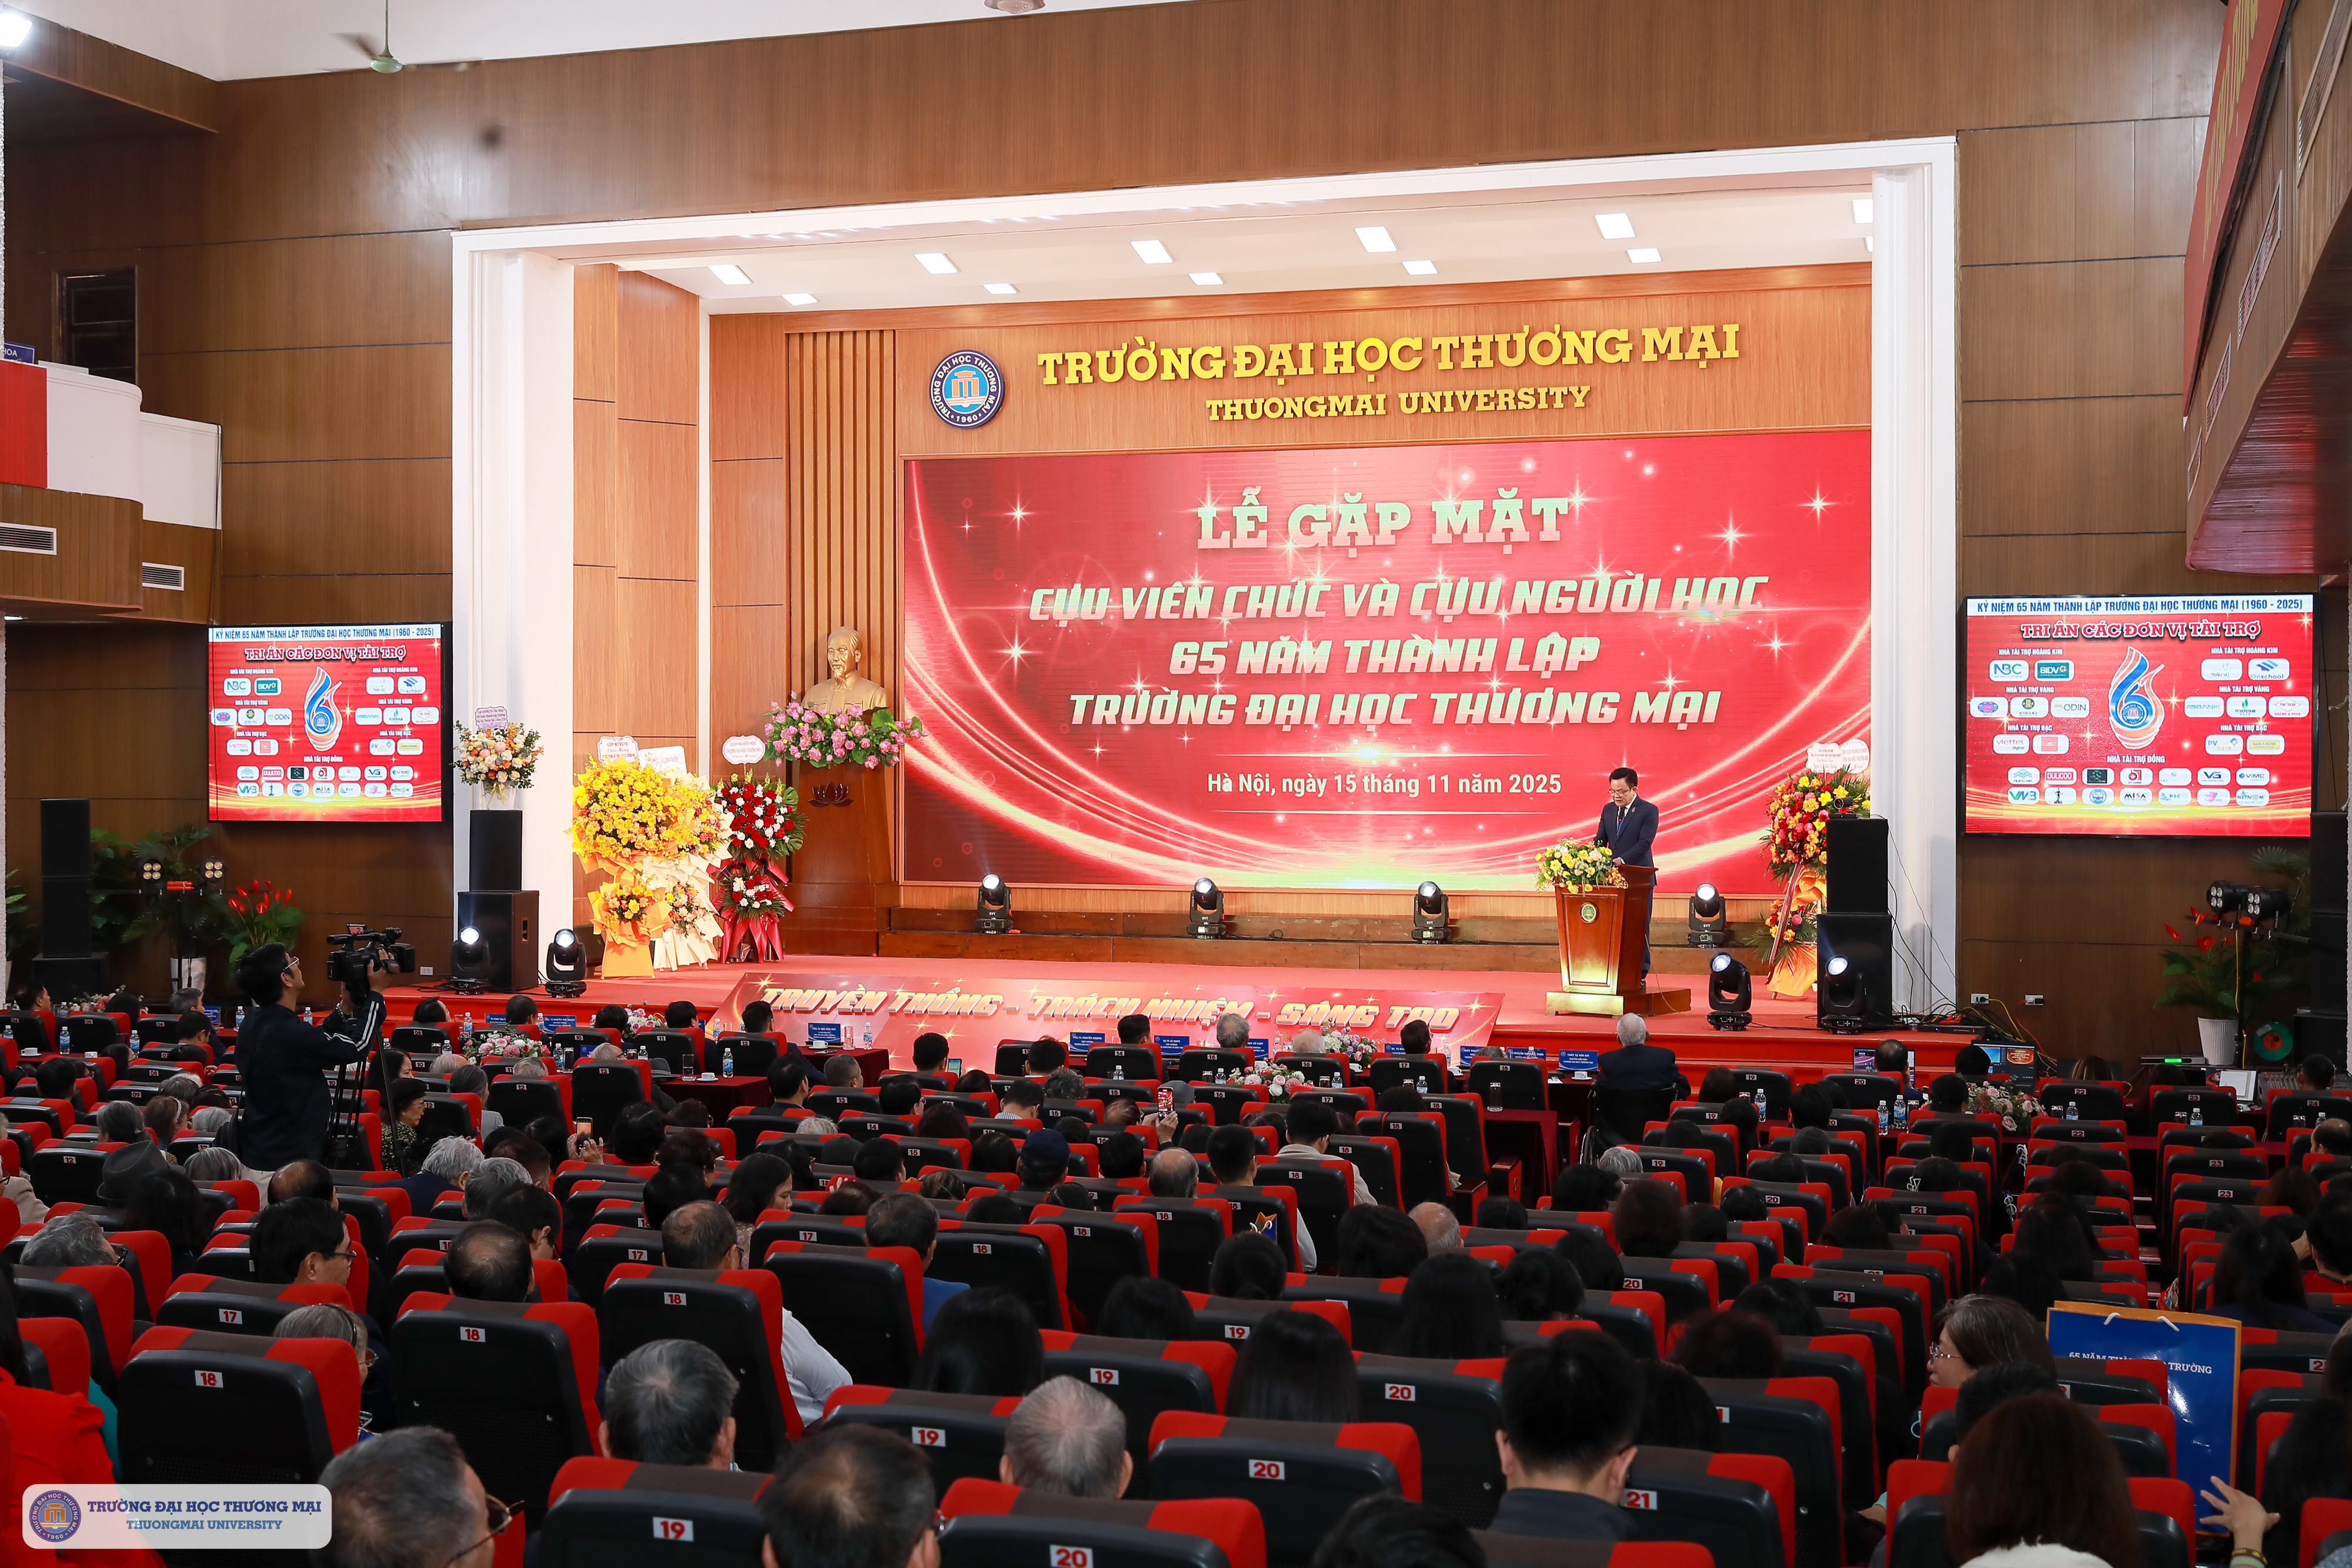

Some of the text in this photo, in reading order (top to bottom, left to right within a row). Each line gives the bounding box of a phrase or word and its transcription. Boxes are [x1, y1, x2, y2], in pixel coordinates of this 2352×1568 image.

[1038, 324, 1739, 385] TRƯỜNG ĐẠI HỌC THƯƠNG MẠI
[933, 355, 997, 418] TRƯỜNG ĐẠI HỌC THƯƠNG MẠI
[1206, 386, 1591, 421] THUONGMAI UNIVERSITY
[1197, 486, 1568, 558] LỄ GẶP MẶT
[1029, 570, 1769, 627] CỰU VIÊN CHỨC VÀ CỰU NGƯỜI HỌC
[1977, 600, 1988, 612] KỶ
[1992, 601, 2014, 614] NIỆM
[2017, 602, 2027, 611] 65
[2030, 600, 2050, 612] NĂM
[2054, 600, 2083, 612] THÀNH
[2085, 601, 2102, 613] LẬP
[2104, 600, 2140, 611] TRƯỜNG
[2143, 600, 2157, 613] ĐẠI
[2161, 600, 2179, 612] HỌC
[2182, 600, 2219, 610] THƯƠNG
[2221, 600, 2239, 611] MẠI
[2241, 600, 2267, 610] (1960
[2277, 599, 2303, 610] 2025)
[216, 630, 223, 639] KỶ
[225, 630, 240, 640] NIỆM
[252, 630, 265, 638] NĂM
[267, 629, 286, 638] THÀNH
[288, 630, 299, 639] LẬP
[302, 629, 325, 638] TRƯỜNG
[327, 630, 336, 638] ĐẠI
[339, 629, 350, 638] HỌC
[353, 628, 376, 637] THƯƠNG
[379, 628, 390, 638] MẠI
[393, 628, 410, 637] (1960
[2022, 620, 2261, 640] TRI ÂN CÁC ĐƠN VỊ TÀI TRỢ
[245, 645, 406, 661] TRI ÂN CÁC ĐƠN VỊ TÀI TRỢ
[1169, 631, 1601, 678] 65 NĂM THÀNH LẬP
[1070, 686, 1721, 732] TRƯỜNG ĐẠI HỌC THƯƠNG MẠI
[2107, 755, 2120, 763] NHÀ
[2122, 755, 2133, 763] TÀI
[2134, 755, 2146, 764] TRỢ
[1208, 773, 1561, 797] Hà Nội, ngày 15 tháng 11 năm 2025
[764, 984, 888, 1014] TRUYỀN
[888, 987, 1004, 1016] THỐNG
[1027, 993, 1141, 1019] TRÁCH
[1139, 997, 1254, 1028] NHIỆM
[1275, 1001, 1379, 1028] SÁNG
[978, 1245, 987, 1253] 18
[670, 1294, 681, 1304] 18
[1838, 1293, 1851, 1302] 21
[223, 1310, 236, 1322] 17
[466, 1328, 480, 1340] 18
[2169, 1362, 2212, 1374] TRƯỜNG
[201, 1372, 217, 1386] 18
[1096, 1370, 1113, 1383] 19
[1389, 1386, 1411, 1399] 20
[918, 1430, 938, 1445] 19
[1254, 1462, 1279, 1479] 20
[1626, 1492, 1651, 1508] 21
[660, 1520, 685, 1539] 19
[1057, 1548, 1087, 1567] 20
